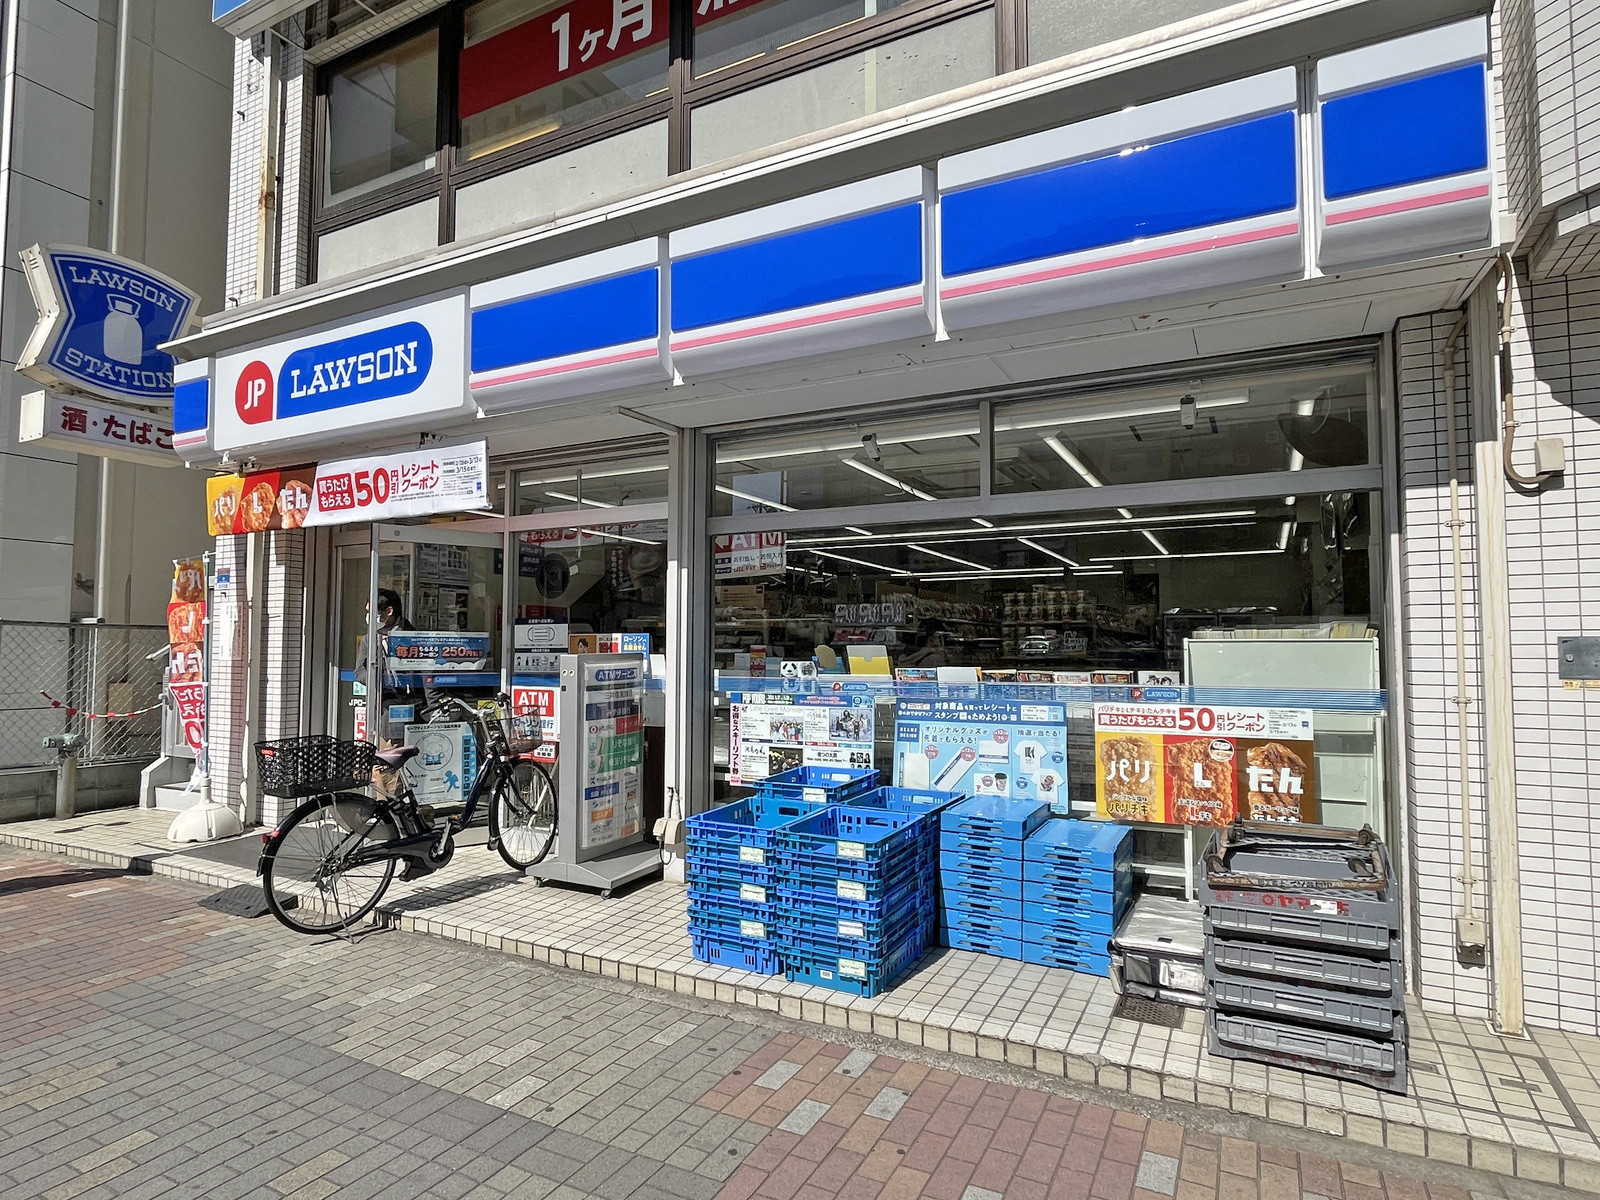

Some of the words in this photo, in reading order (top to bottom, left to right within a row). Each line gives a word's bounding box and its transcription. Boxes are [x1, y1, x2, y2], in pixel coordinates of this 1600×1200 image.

[551, 0, 653, 72] 1ヶ月
[69, 265, 177, 313] LAWSON
[64, 347, 174, 388] STATION
[290, 340, 418, 399] LAWSON
[244, 380, 267, 411] JP
[60, 404, 175, 451] 酒・たばこ
[401, 460, 440, 478] レシート
[320, 476, 349, 493] 買うたび
[355, 468, 390, 507] 50
[401, 475, 440, 492] クーポン
[214, 495, 236, 516] パリ
[253, 491, 262, 513] L
[279, 486, 308, 511] たん
[321, 493, 351, 508] もらえる
[396, 645, 419, 658] 毎月
[598, 667, 637, 680] ATMサービス
[518, 691, 549, 706] ATM
[935, 711, 959, 719] スタンプ
[1100, 715, 1175, 727] 買うたびもらえる
[1178, 707, 1215, 732] 50
[1227, 712, 1265, 722] レシート
[924, 726, 988, 735] オリジナルグッズが
[1227, 721, 1266, 732] クーポン
[924, 735, 977, 745] 先着でもらえる!
[1106, 759, 1150, 784] パリ
[1193, 762, 1213, 788] L
[1245, 765, 1304, 795] たん
[1108, 802, 1149, 815] パリチキ
[1189, 806, 1212, 821] Lチキ
